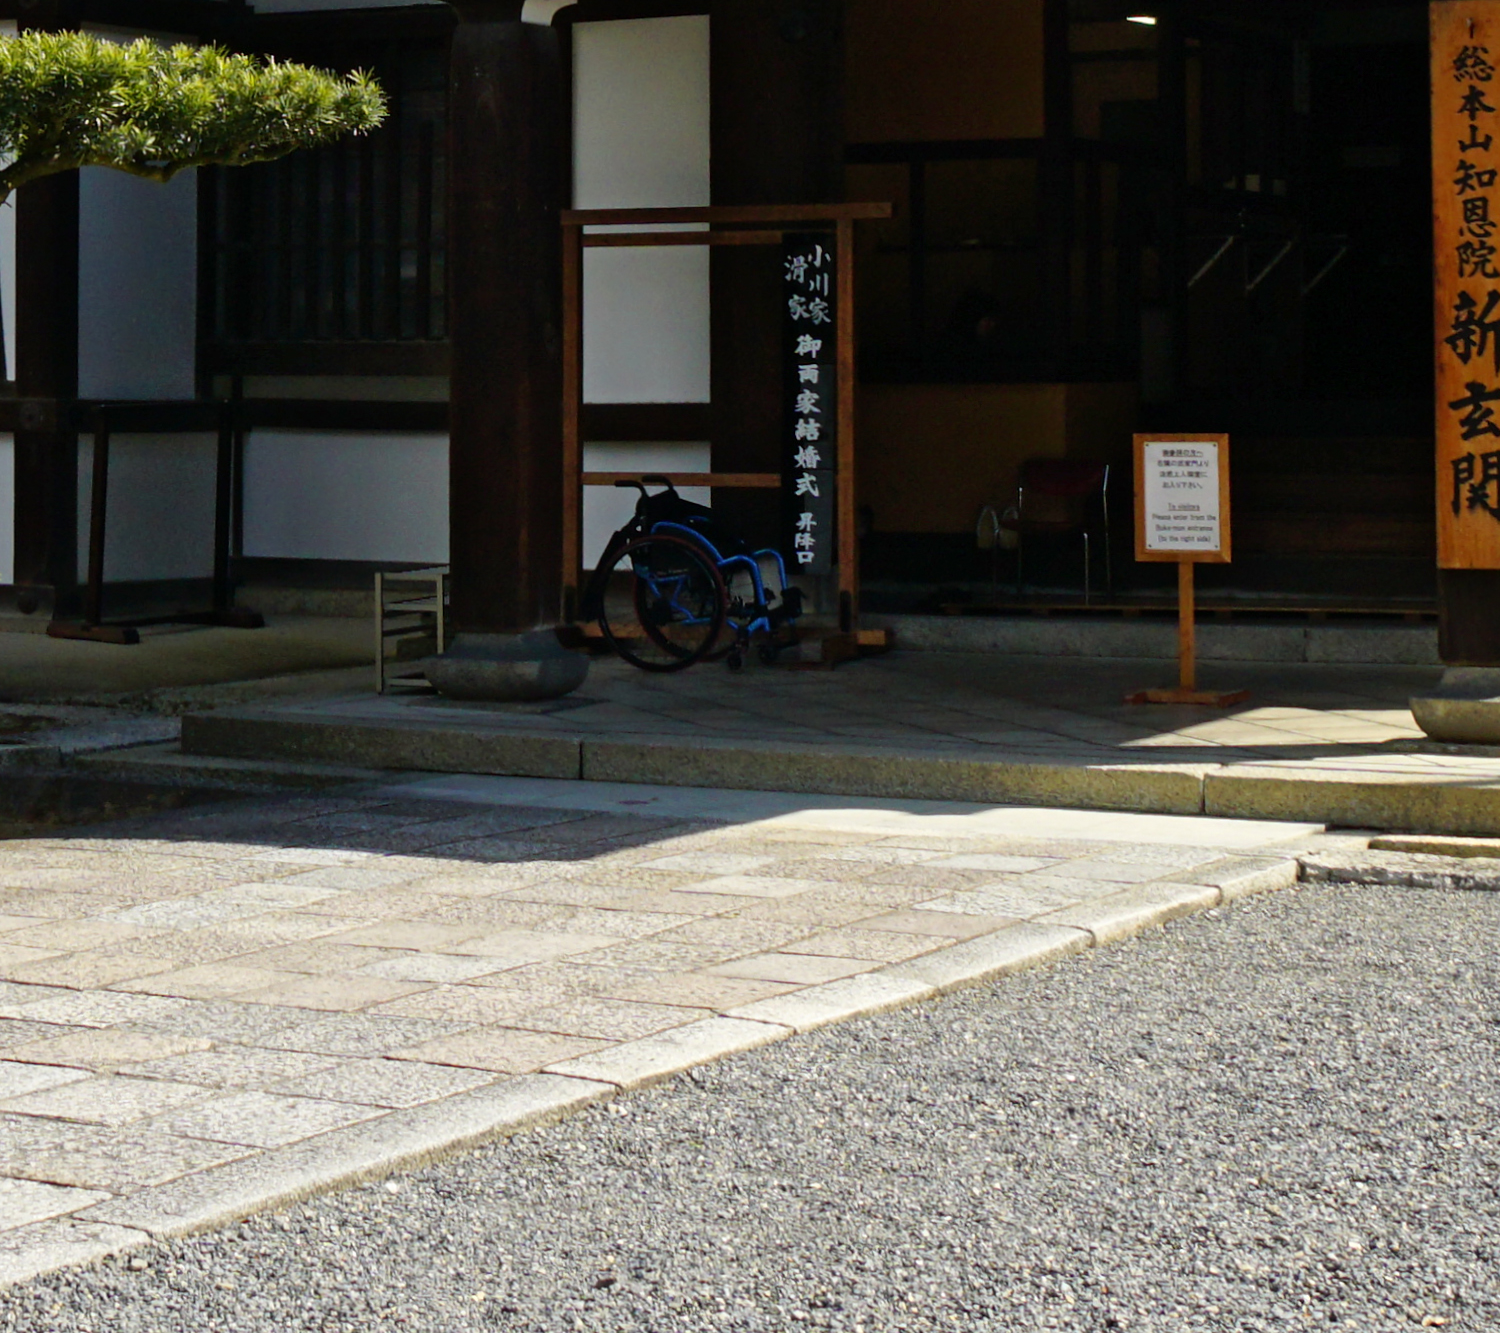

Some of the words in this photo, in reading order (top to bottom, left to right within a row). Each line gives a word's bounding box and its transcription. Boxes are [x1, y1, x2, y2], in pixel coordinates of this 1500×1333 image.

[783, 254, 811, 321] 滑家
[807, 243, 832, 325] 小川家
[793, 333, 823, 498] 御両家結婚式
